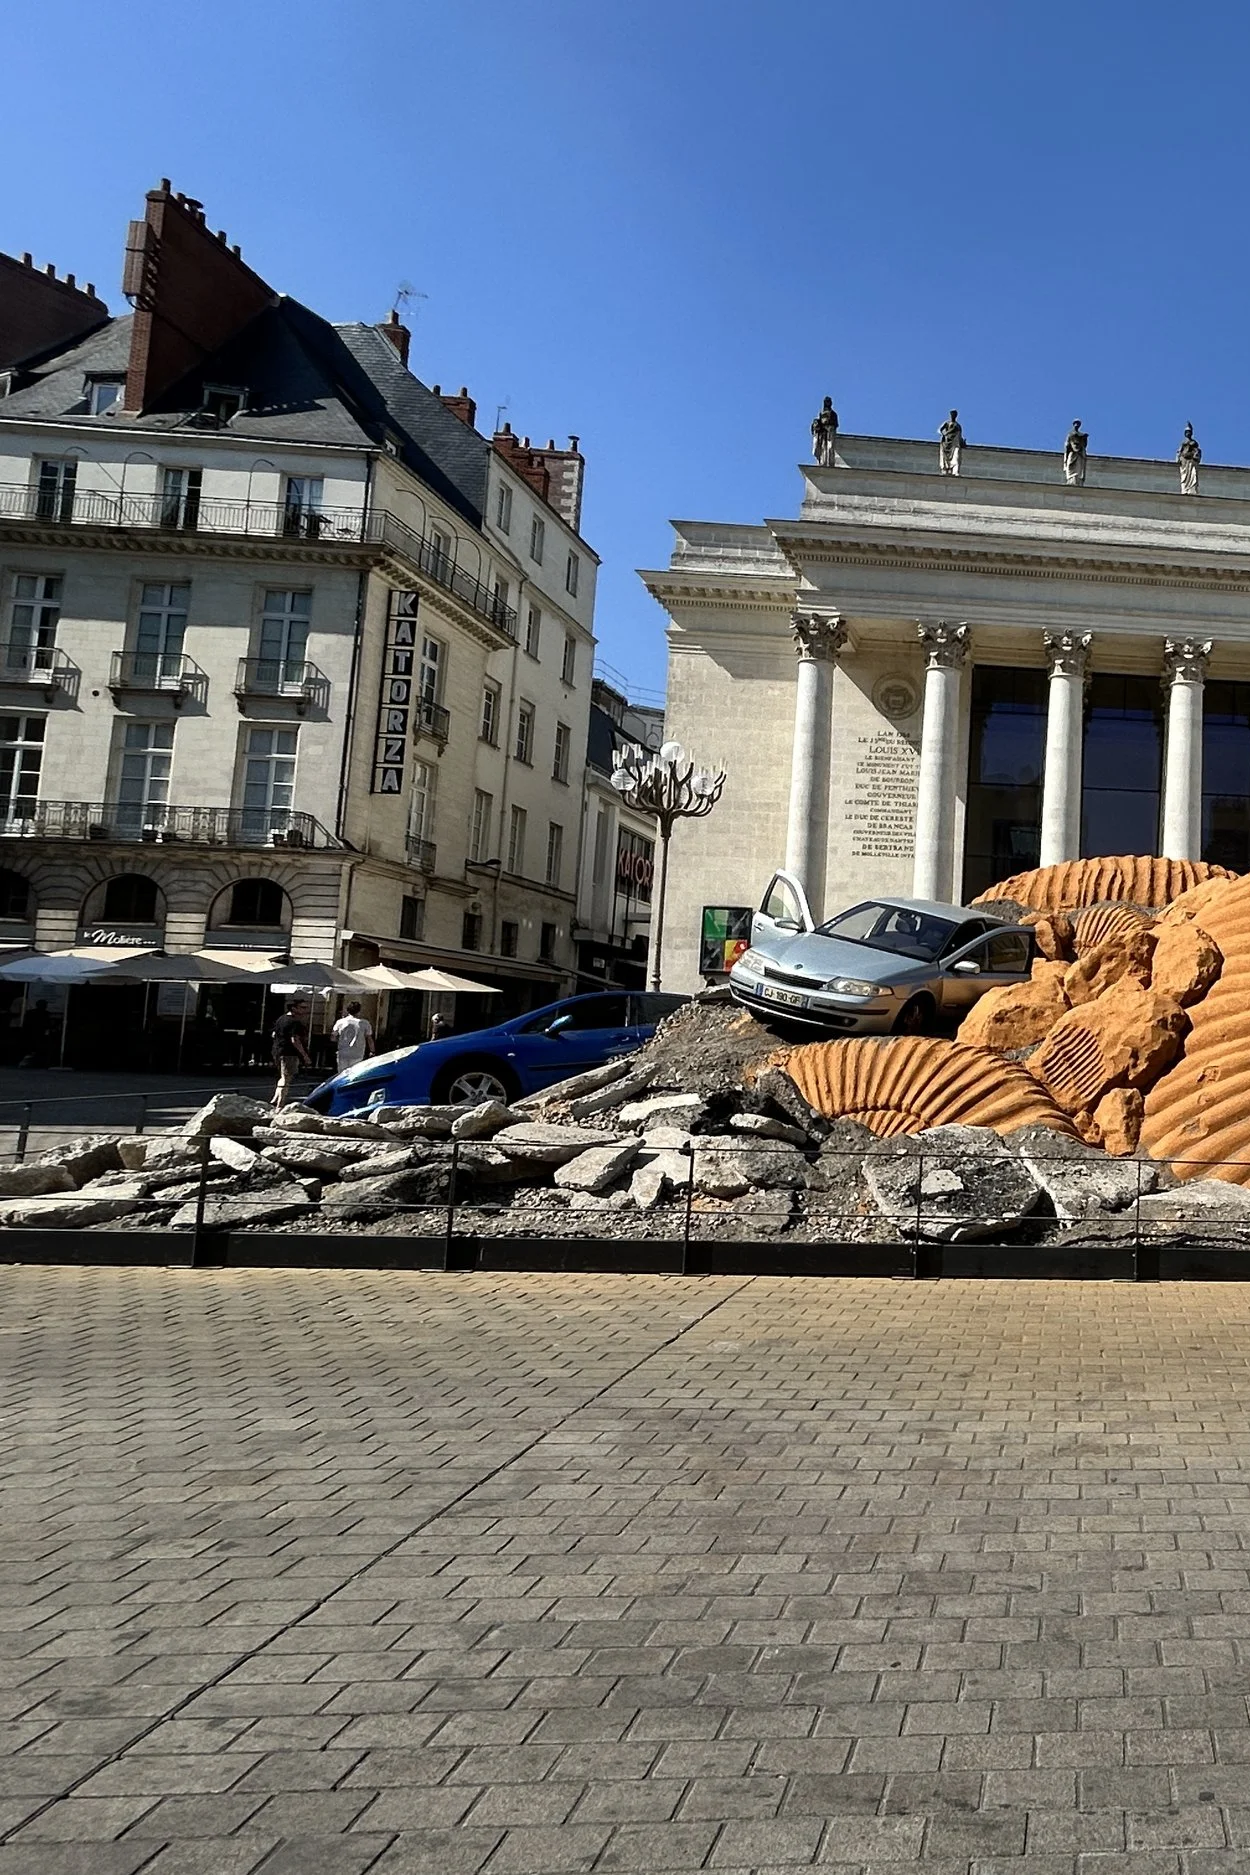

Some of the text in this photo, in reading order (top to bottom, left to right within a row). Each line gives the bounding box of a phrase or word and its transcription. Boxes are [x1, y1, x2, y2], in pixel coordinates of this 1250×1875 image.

[382, 592, 416, 791] KATORZA
[869, 746, 898, 754] LOUIS
[618, 849, 654, 888] KATOR
